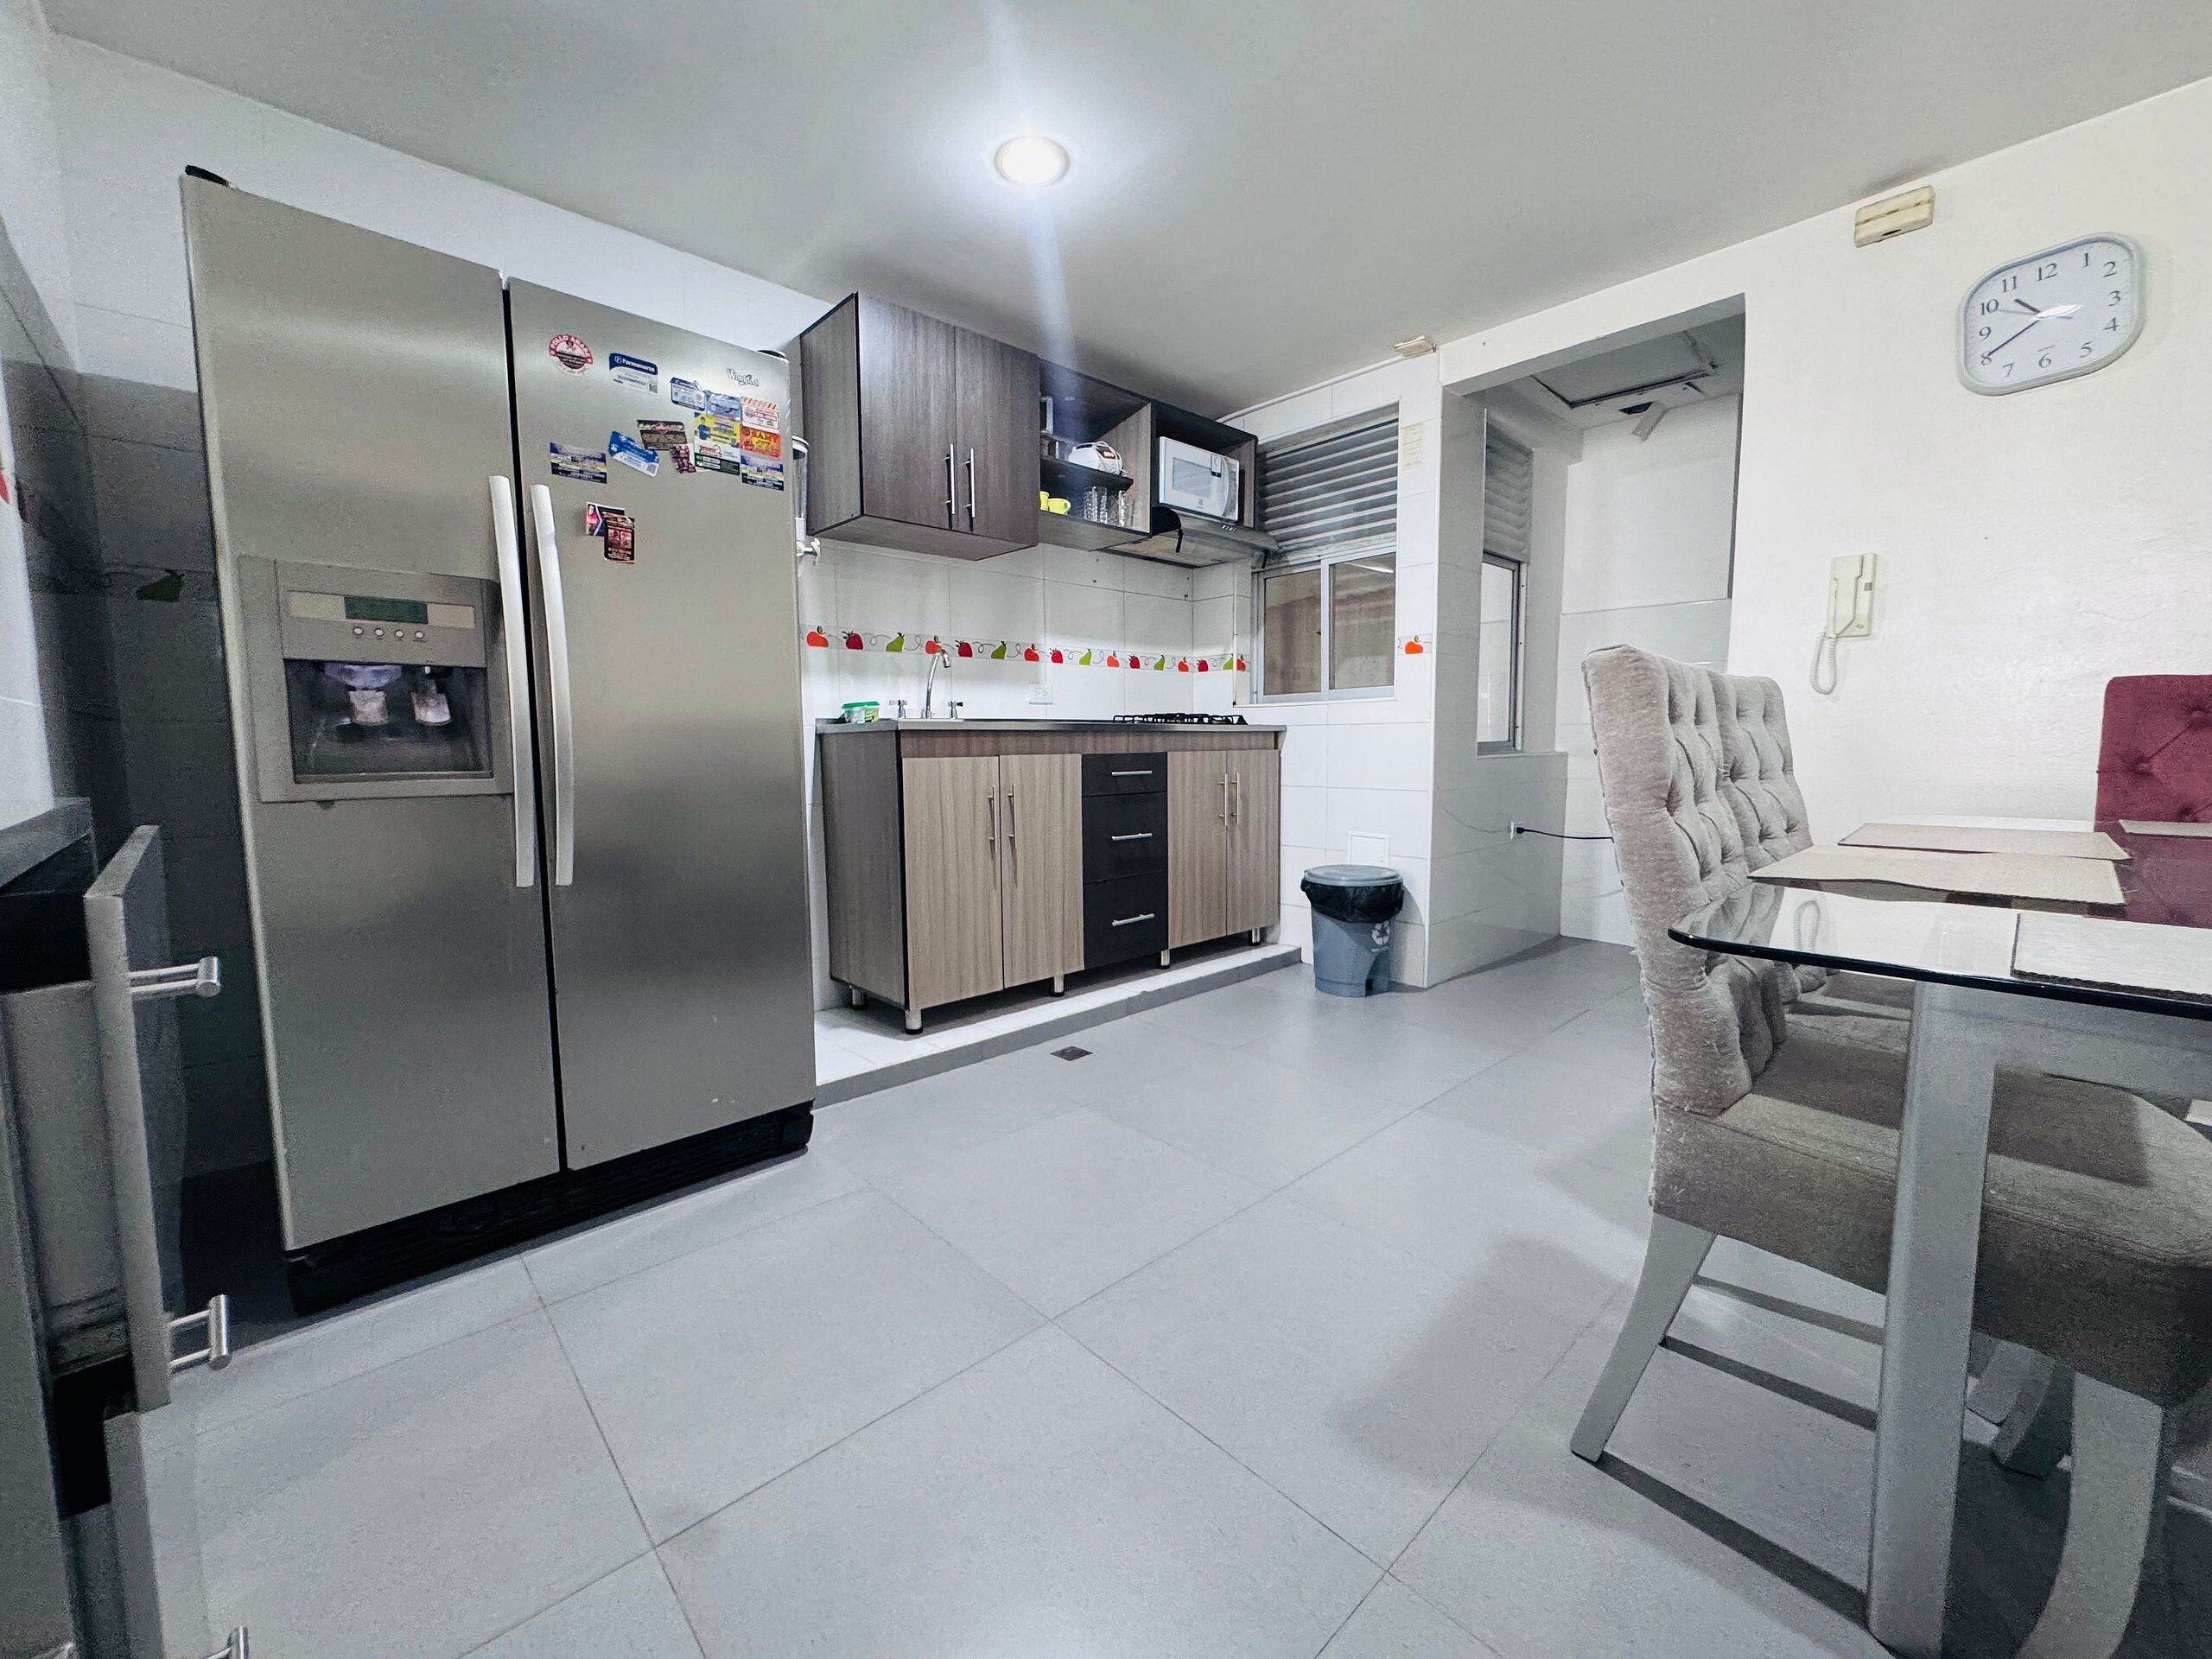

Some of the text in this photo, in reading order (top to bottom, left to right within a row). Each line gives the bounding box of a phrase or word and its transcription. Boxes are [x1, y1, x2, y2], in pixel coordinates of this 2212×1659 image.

[2083, 252, 2090, 268] 1
[2037, 263, 2057, 282] 12
[2102, 261, 2117, 277] 2
[2002, 276, 2018, 293] 11
[2108, 290, 2121, 307] 3
[1980, 299, 1999, 315] 10
[2102, 317, 2118, 332] 4
[1979, 327, 1991, 342] 9
[2079, 341, 2093, 358] 5
[1980, 351, 1992, 365] 8
[2038, 353, 2052, 368] 6
[2002, 363, 2013, 378] 7
